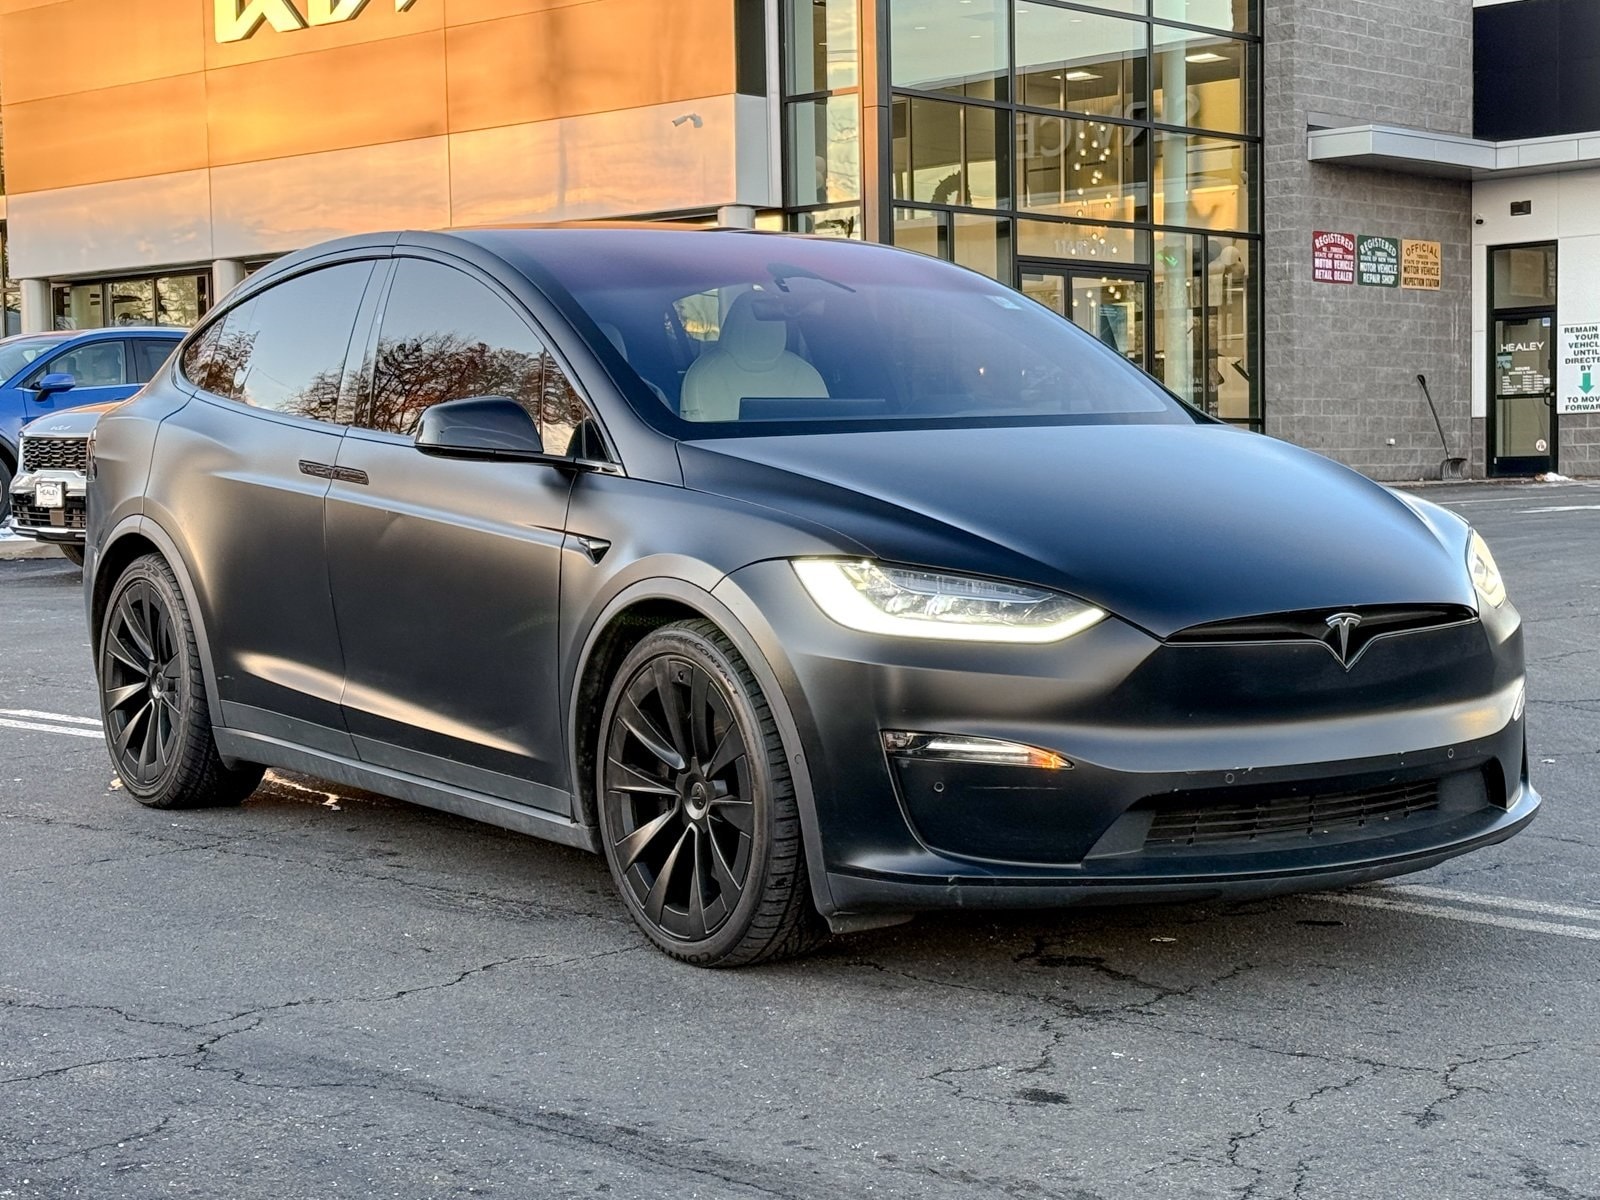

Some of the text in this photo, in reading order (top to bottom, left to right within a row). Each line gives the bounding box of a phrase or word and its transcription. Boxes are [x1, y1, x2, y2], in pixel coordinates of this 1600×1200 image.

[1314, 233, 1353, 251] REGISTERED
[1360, 238, 1397, 256] REGISTERED
[1406, 243, 1438, 259] OFFICIAL
[1314, 258, 1353, 270] MOTOR VEHICLE
[1359, 262, 1398, 274] MOTOR VEHICLE
[1314, 269, 1353, 281] RETAIL DEALER
[1404, 265, 1440, 276] MOTOR VEHICLE
[1362, 273, 1395, 285] REPAIR SHOP
[1403, 277, 1440, 288] INSPECTION STATION
[1564, 325, 1598, 334] REMAIN
[1575, 333, 1599, 341] YOUR
[1500, 341, 1545, 352] HEALEY
